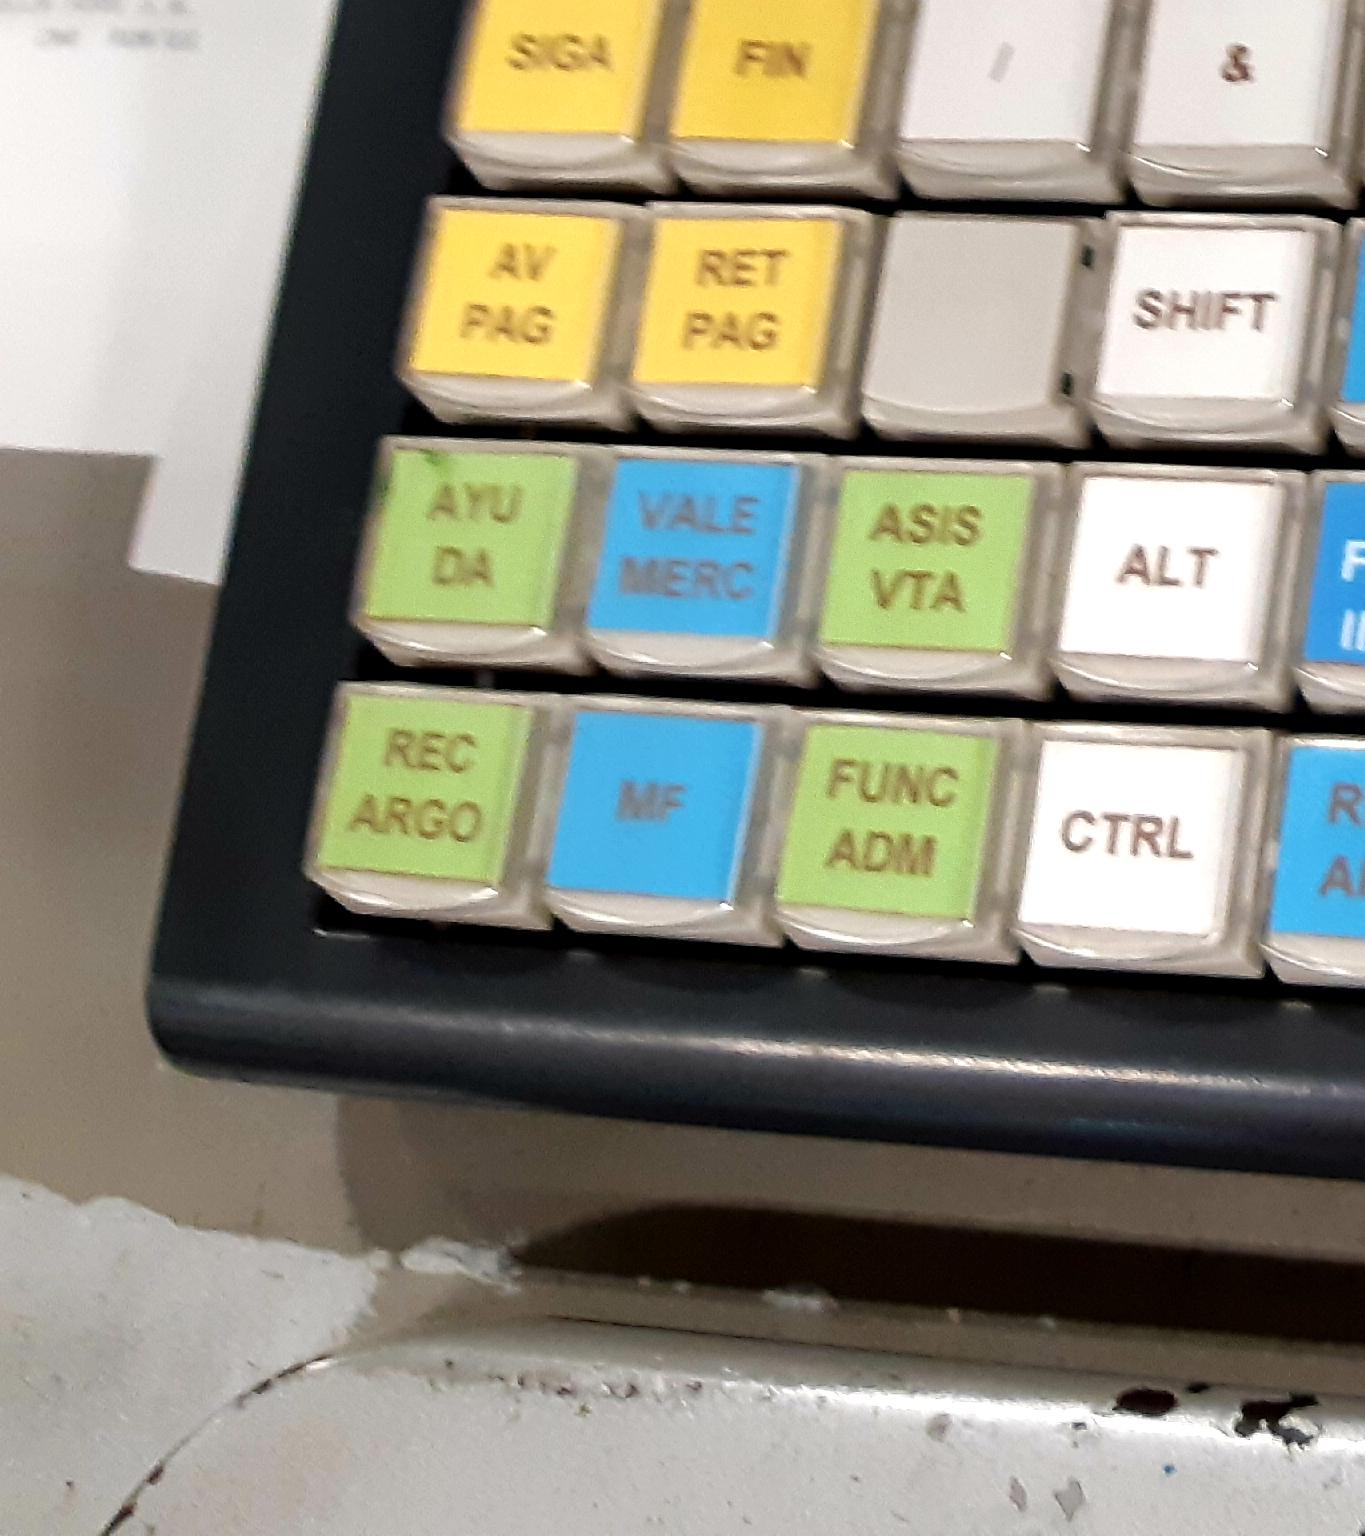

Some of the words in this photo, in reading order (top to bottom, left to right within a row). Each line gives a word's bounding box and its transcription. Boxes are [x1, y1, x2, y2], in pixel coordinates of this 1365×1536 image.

[507, 34, 611, 72] SIGA
[736, 40, 809, 77] FIN
[490, 244, 554, 281] AV
[697, 249, 788, 287] RET
[461, 303, 554, 345] PAG
[1134, 289, 1277, 331] SHIFT
[683, 312, 779, 351] PAG
[426, 482, 521, 524] AYU
[639, 493, 759, 536] VALE
[869, 504, 982, 547] ASIS
[432, 546, 493, 587] DA
[618, 556, 755, 601] MERC
[1117, 545, 1218, 587] ALT
[872, 570, 964, 612] VTA
[383, 728, 476, 774] REC
[616, 780, 686, 822] MF
[826, 758, 959, 807] FUNC
[347, 794, 483, 843] ARGO
[1061, 810, 1193, 860] CTRL
[825, 829, 937, 877] ADM
